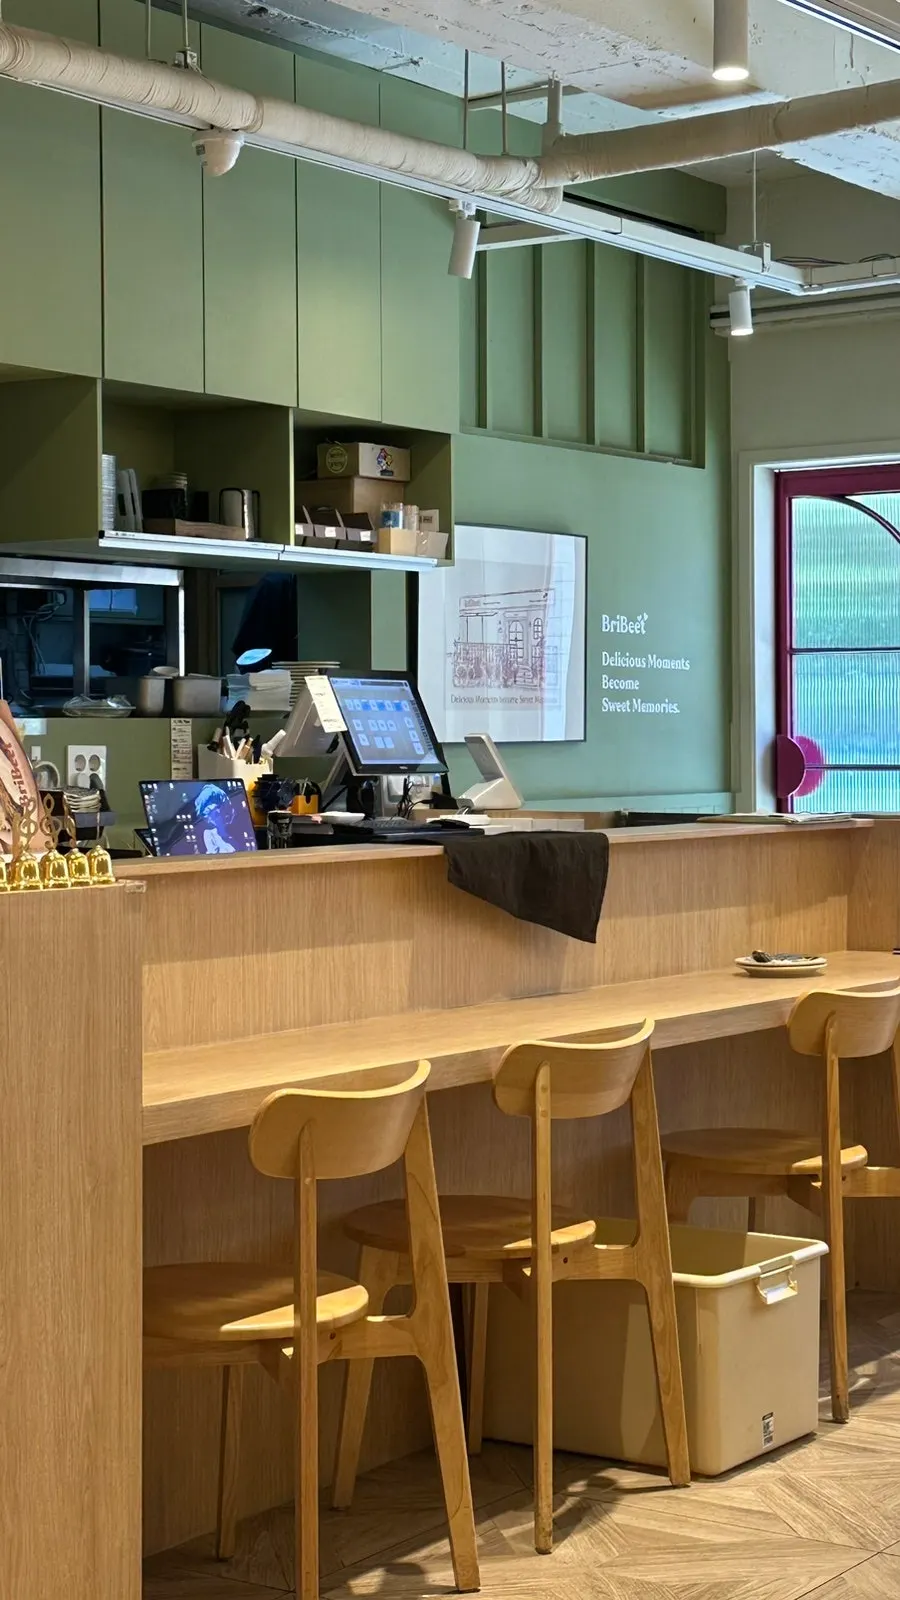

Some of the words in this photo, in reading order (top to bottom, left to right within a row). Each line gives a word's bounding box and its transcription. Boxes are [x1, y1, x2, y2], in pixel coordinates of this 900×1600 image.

[602, 613, 647, 634] BriBeet
[602, 651, 647, 668] Delicious
[647, 654, 691, 670] Moments
[602, 674, 640, 690] Become
[602, 697, 631, 713] Sweet
[632, 698, 680, 713] Memories.
